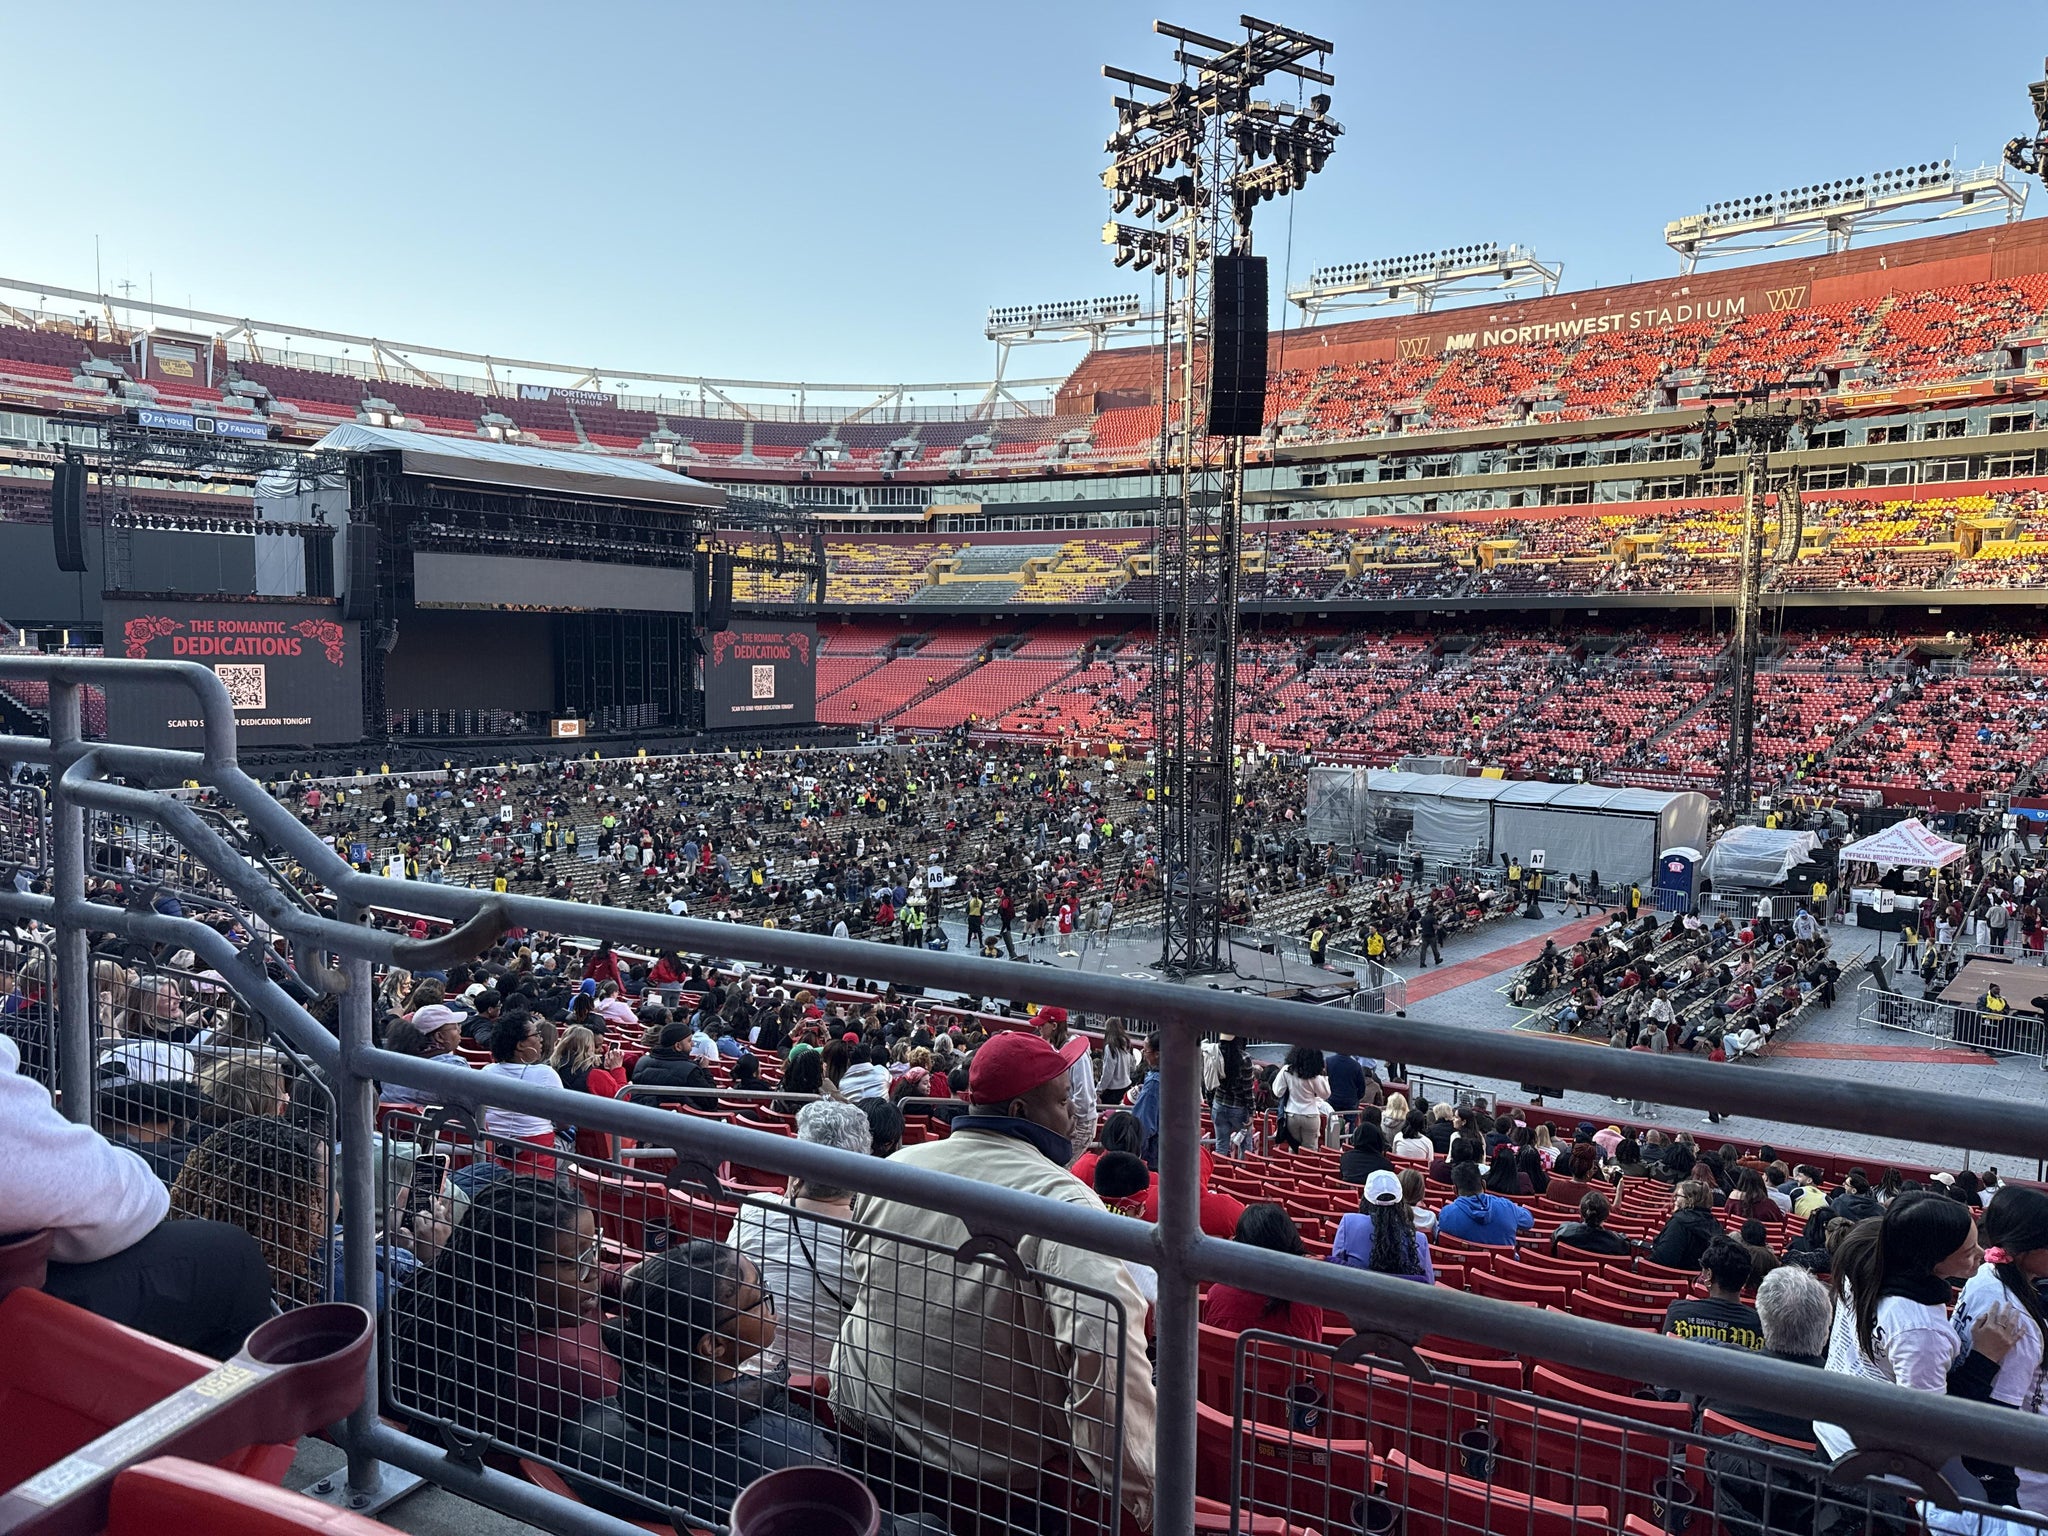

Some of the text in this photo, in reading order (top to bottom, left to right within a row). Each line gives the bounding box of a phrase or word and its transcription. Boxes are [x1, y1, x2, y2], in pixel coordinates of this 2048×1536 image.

[1483, 313, 1625, 348] NORTHWEST
[1629, 297, 1745, 328] STADIUM
[552, 388, 614, 402] NORTHWEST
[1925, 390, 1932, 398] 7
[565, 397, 602, 407] STADIUM
[153, 415, 193, 428] FANDUEL
[230, 425, 267, 436] FANDUEL
[189, 620, 286, 635] THE ROMANTIC
[742, 633, 784, 643] THE ROMANTIC
[173, 636, 302, 656] DEDICATIONS
[734, 645, 791, 659] DEDICATIONS
[241, 718, 281, 727] DEDICATION
[283, 717, 312, 725] TONIGHT
[502, 809, 511, 818] A1
[1532, 854, 1544, 863] A7
[1845, 852, 1934, 866] OFFICIAL BRUNO MARS MERCH
[929, 873, 943, 882] A6
[1883, 898, 1893, 906] A12
[1674, 1320, 1766, 1352] Bruno Ma
